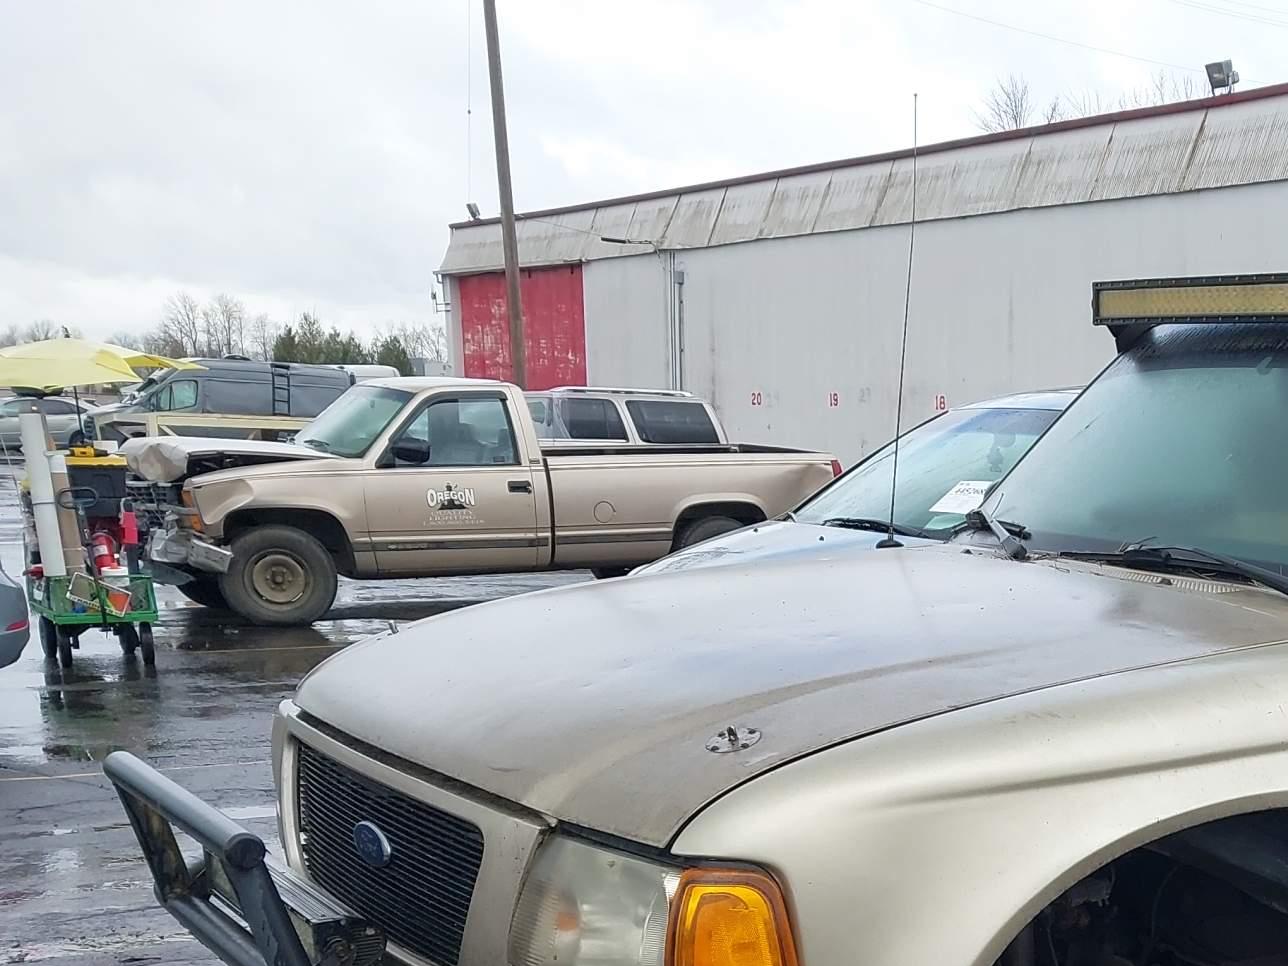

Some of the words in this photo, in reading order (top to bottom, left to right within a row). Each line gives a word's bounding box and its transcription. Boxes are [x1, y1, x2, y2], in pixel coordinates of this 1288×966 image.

[751, 393, 762, 405] 20
[829, 393, 839, 406] 19
[935, 395, 946, 410] 18
[426, 488, 476, 508] OREGON
